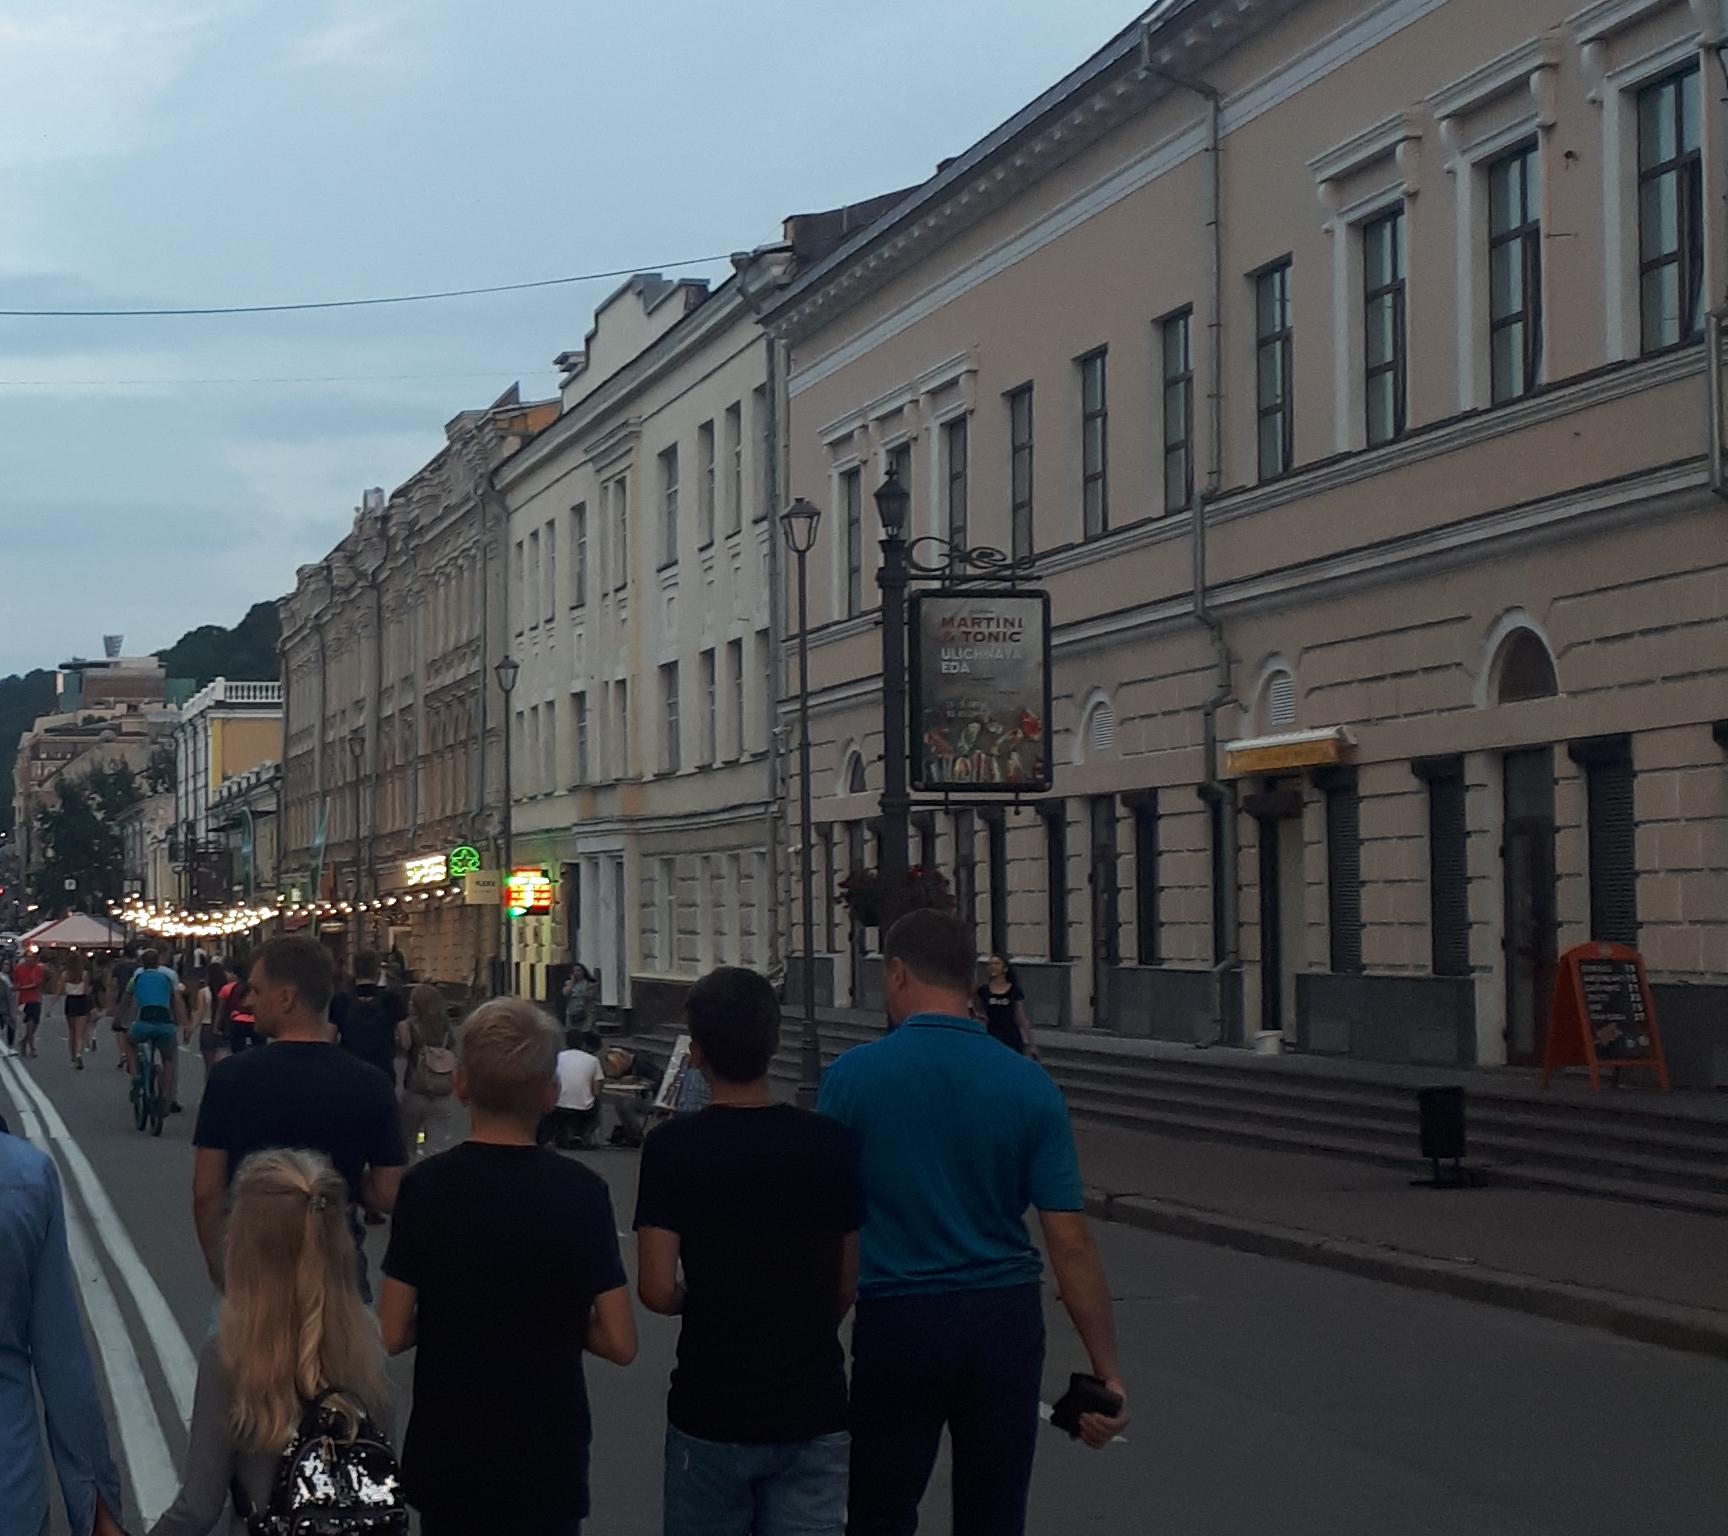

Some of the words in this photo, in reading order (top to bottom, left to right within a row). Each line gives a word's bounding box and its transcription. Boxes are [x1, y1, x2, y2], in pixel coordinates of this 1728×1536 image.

[942, 617, 1023, 628] MARTINI
[961, 631, 1022, 642] TONIC
[941, 661, 970, 674] EDA
